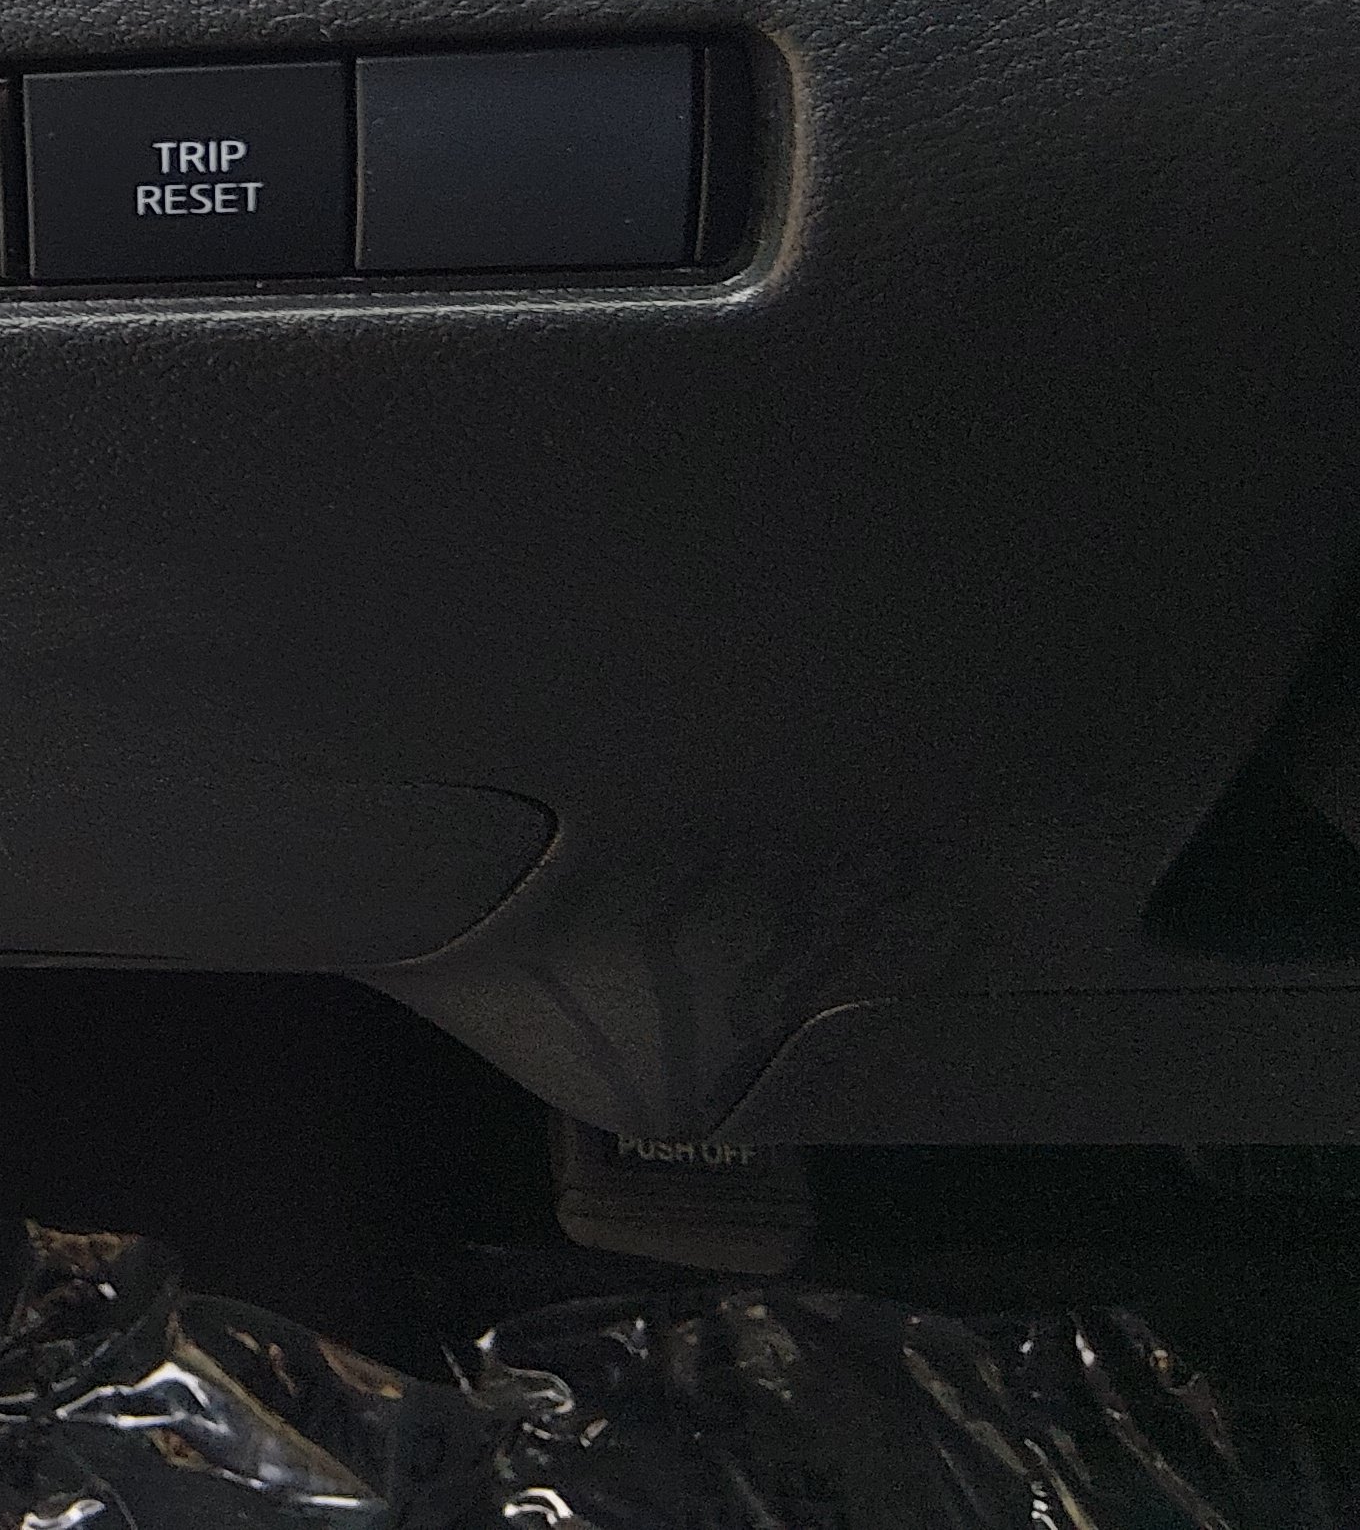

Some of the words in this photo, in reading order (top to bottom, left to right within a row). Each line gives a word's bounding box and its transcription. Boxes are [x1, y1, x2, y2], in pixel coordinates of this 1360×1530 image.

[151, 140, 249, 175] TRIP
[136, 182, 265, 216] RESET
[616, 1133, 695, 1162] PUSH
